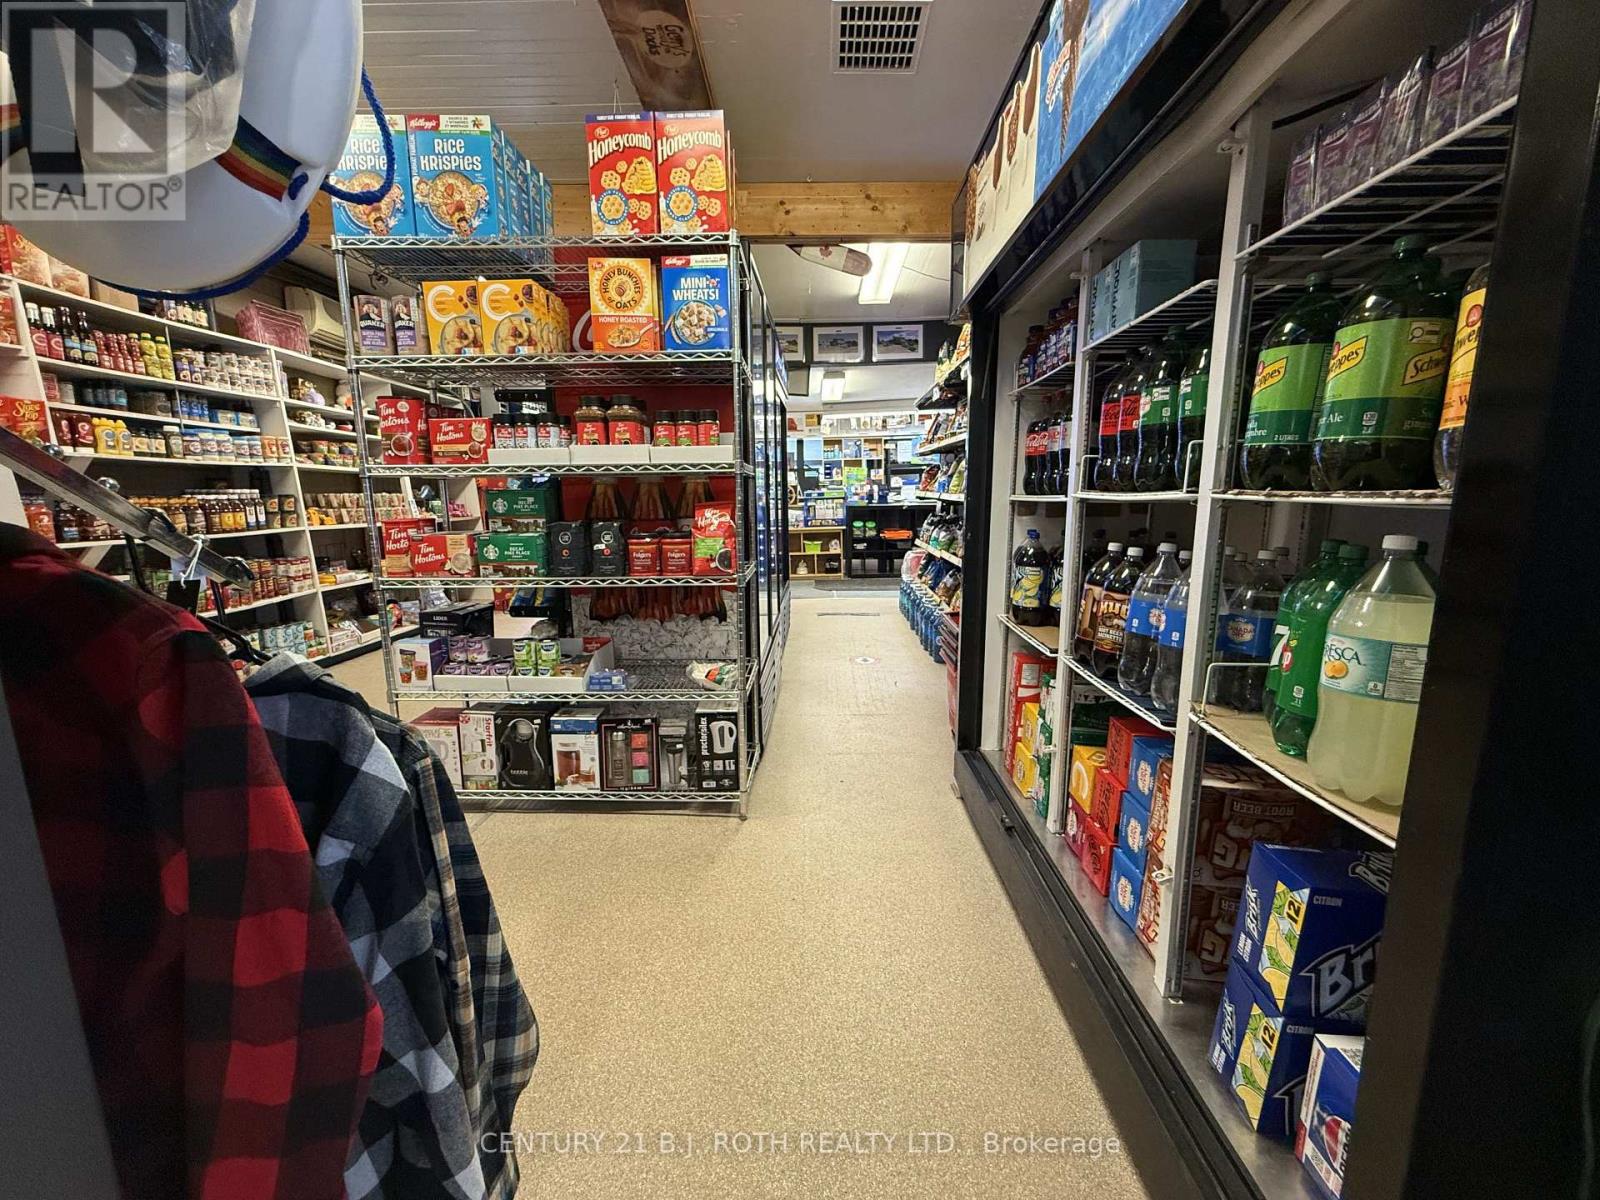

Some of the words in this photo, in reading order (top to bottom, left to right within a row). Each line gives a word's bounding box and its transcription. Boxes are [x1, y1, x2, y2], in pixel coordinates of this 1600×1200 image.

[351, 139, 380, 154] Rice
[434, 138, 465, 154] Rice
[588, 132, 651, 167] Honeycomb
[657, 130, 721, 164] Honeycomb
[603, 269, 616, 294] HONEY
[617, 268, 641, 294] BUNCHES
[615, 297, 638, 310] OATS
[599, 316, 619, 324] HONEY
[620, 316, 648, 324] ROASTED
[379, 403, 396, 416] Tim
[440, 421, 454, 432] Tim
[437, 431, 464, 443] Hortons
[388, 528, 407, 539] Tim
[418, 543, 435, 554] Tim
[414, 553, 446, 565] Hortons
[1313, 895, 1343, 907] CITRON
[1285, 899, 1301, 925] 12
[1262, 1023, 1276, 1050] 12
